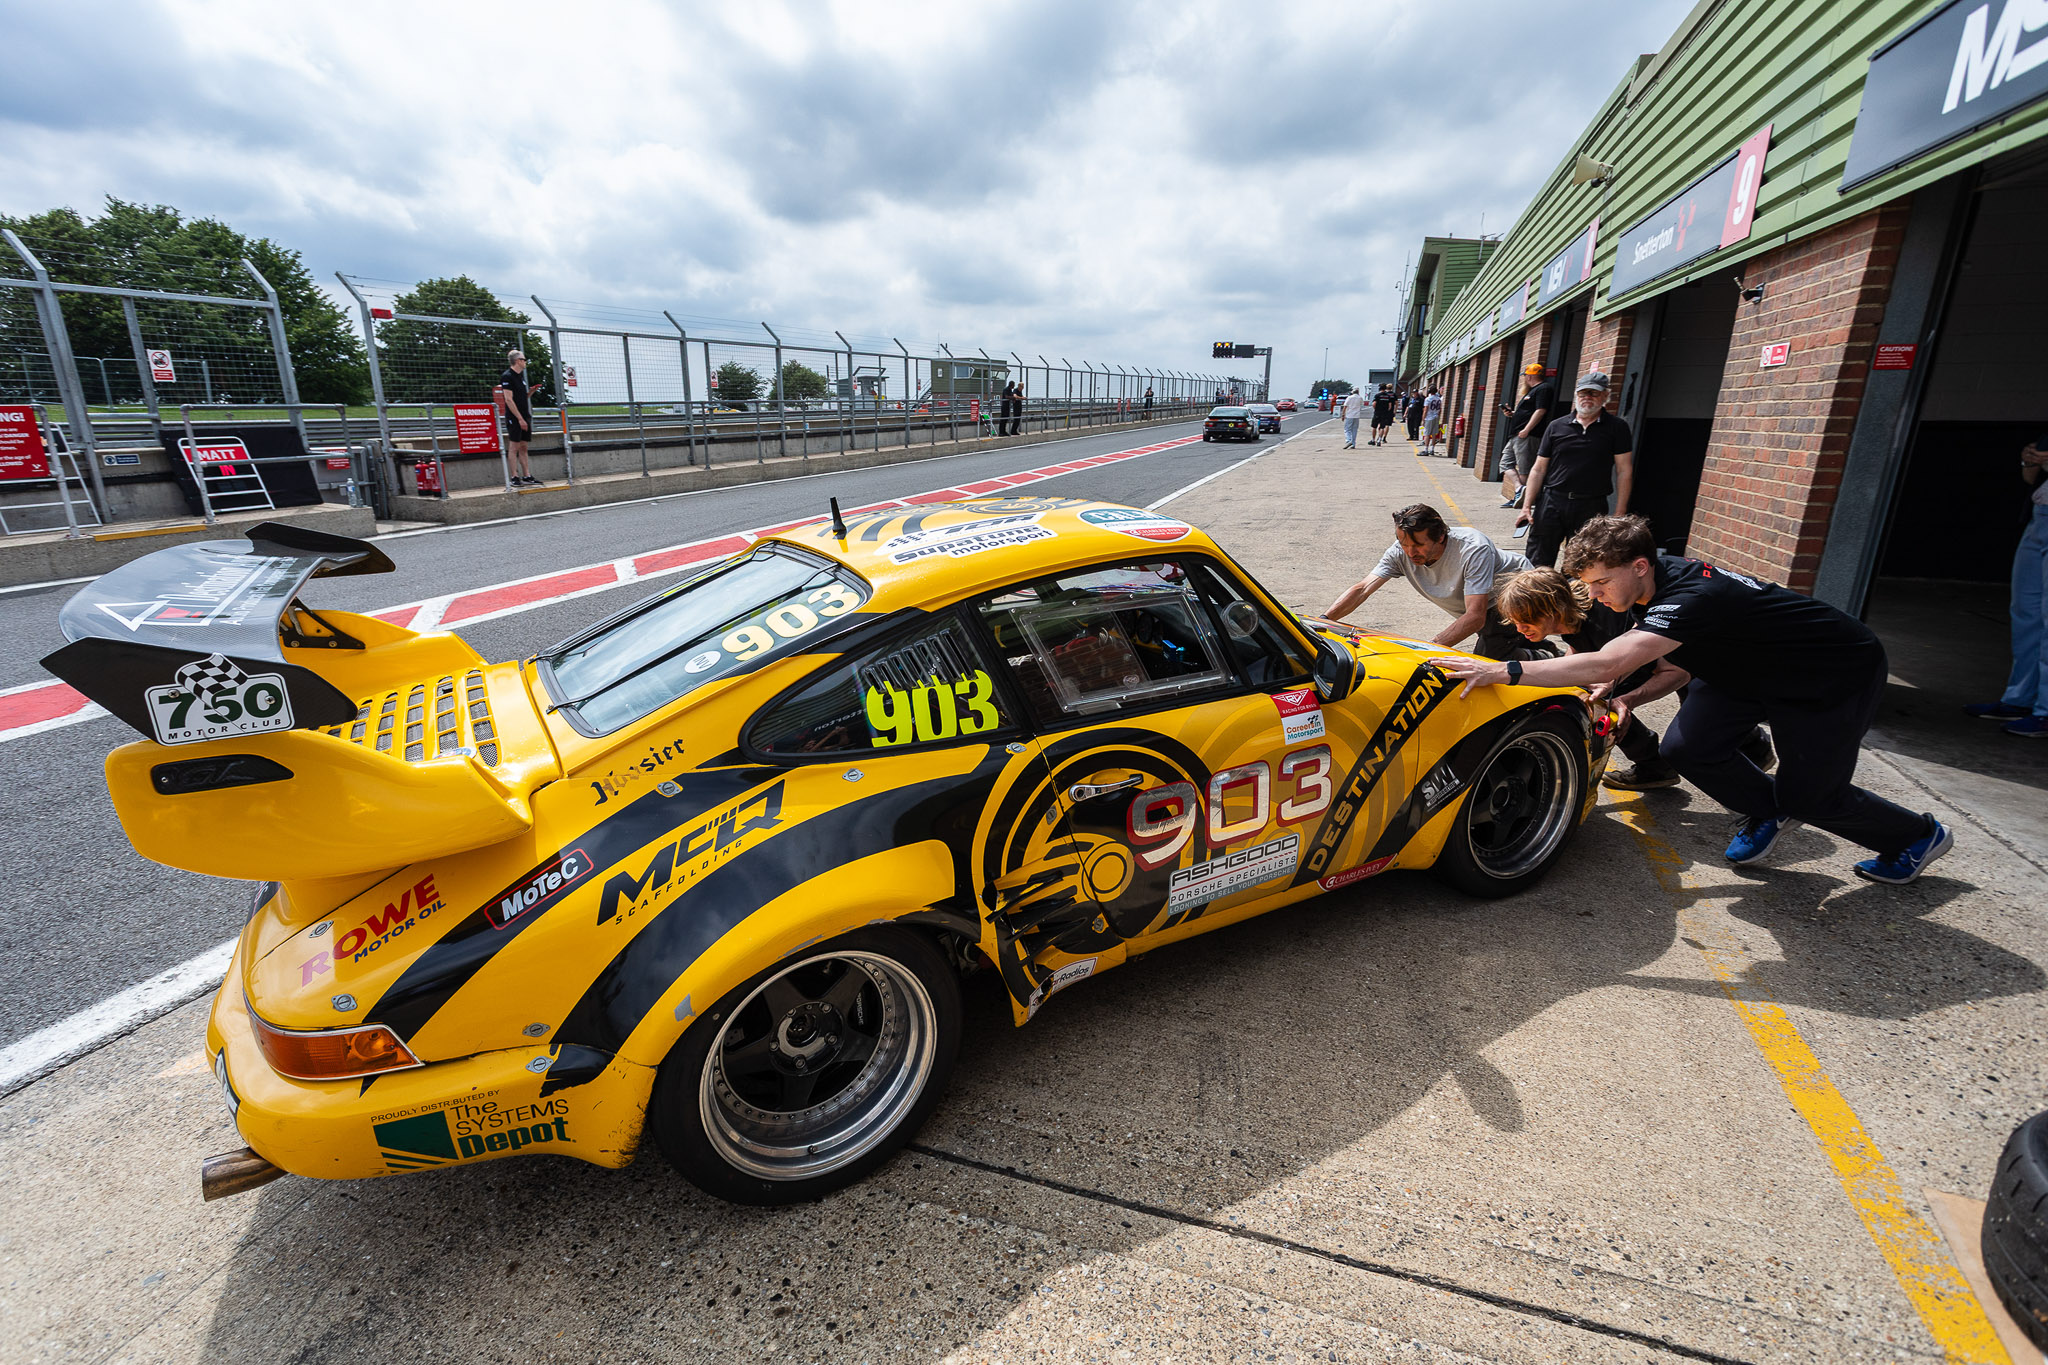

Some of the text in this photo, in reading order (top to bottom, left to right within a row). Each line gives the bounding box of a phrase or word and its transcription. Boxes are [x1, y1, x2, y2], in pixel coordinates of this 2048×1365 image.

[1733, 155, 1756, 225] 9
[1632, 226, 1675, 265] Snetterton
[456, 408, 490, 416] WARNING!
[199, 449, 236, 461] MATT
[219, 464, 237, 476] IN
[894, 525, 1041, 563] Supatune
[951, 530, 1053, 556] motorsport
[722, 584, 860, 661] 903
[158, 682, 283, 730] 750
[168, 718, 282, 740] MOTOR CLUB
[866, 669, 1000, 748] 903
[1287, 726, 1323, 740] Motorsport
[1308, 671, 1443, 873] DESTINATION
[1127, 743, 1332, 871] 903
[615, 840, 742, 925] SCAFFOLDING
[1170, 855, 1296, 904] PORSCHE SPECIALISTS
[1171, 835, 1298, 887] ASHGOOD
[501, 857, 579, 921] MoTeC
[1169, 897, 1203, 914] LOOKING
[1218, 886, 1235, 897] SELL
[1238, 880, 1257, 890] YOUR
[1259, 866, 1295, 883] PORSCHE?
[298, 873, 440, 988] ROWE
[354, 899, 447, 964] MOTOR OIL
[370, 1089, 500, 1123] PROUDLY DISTRIBUTED BY
[449, 1101, 498, 1121] The
[455, 1099, 569, 1136] SYSTEMS
